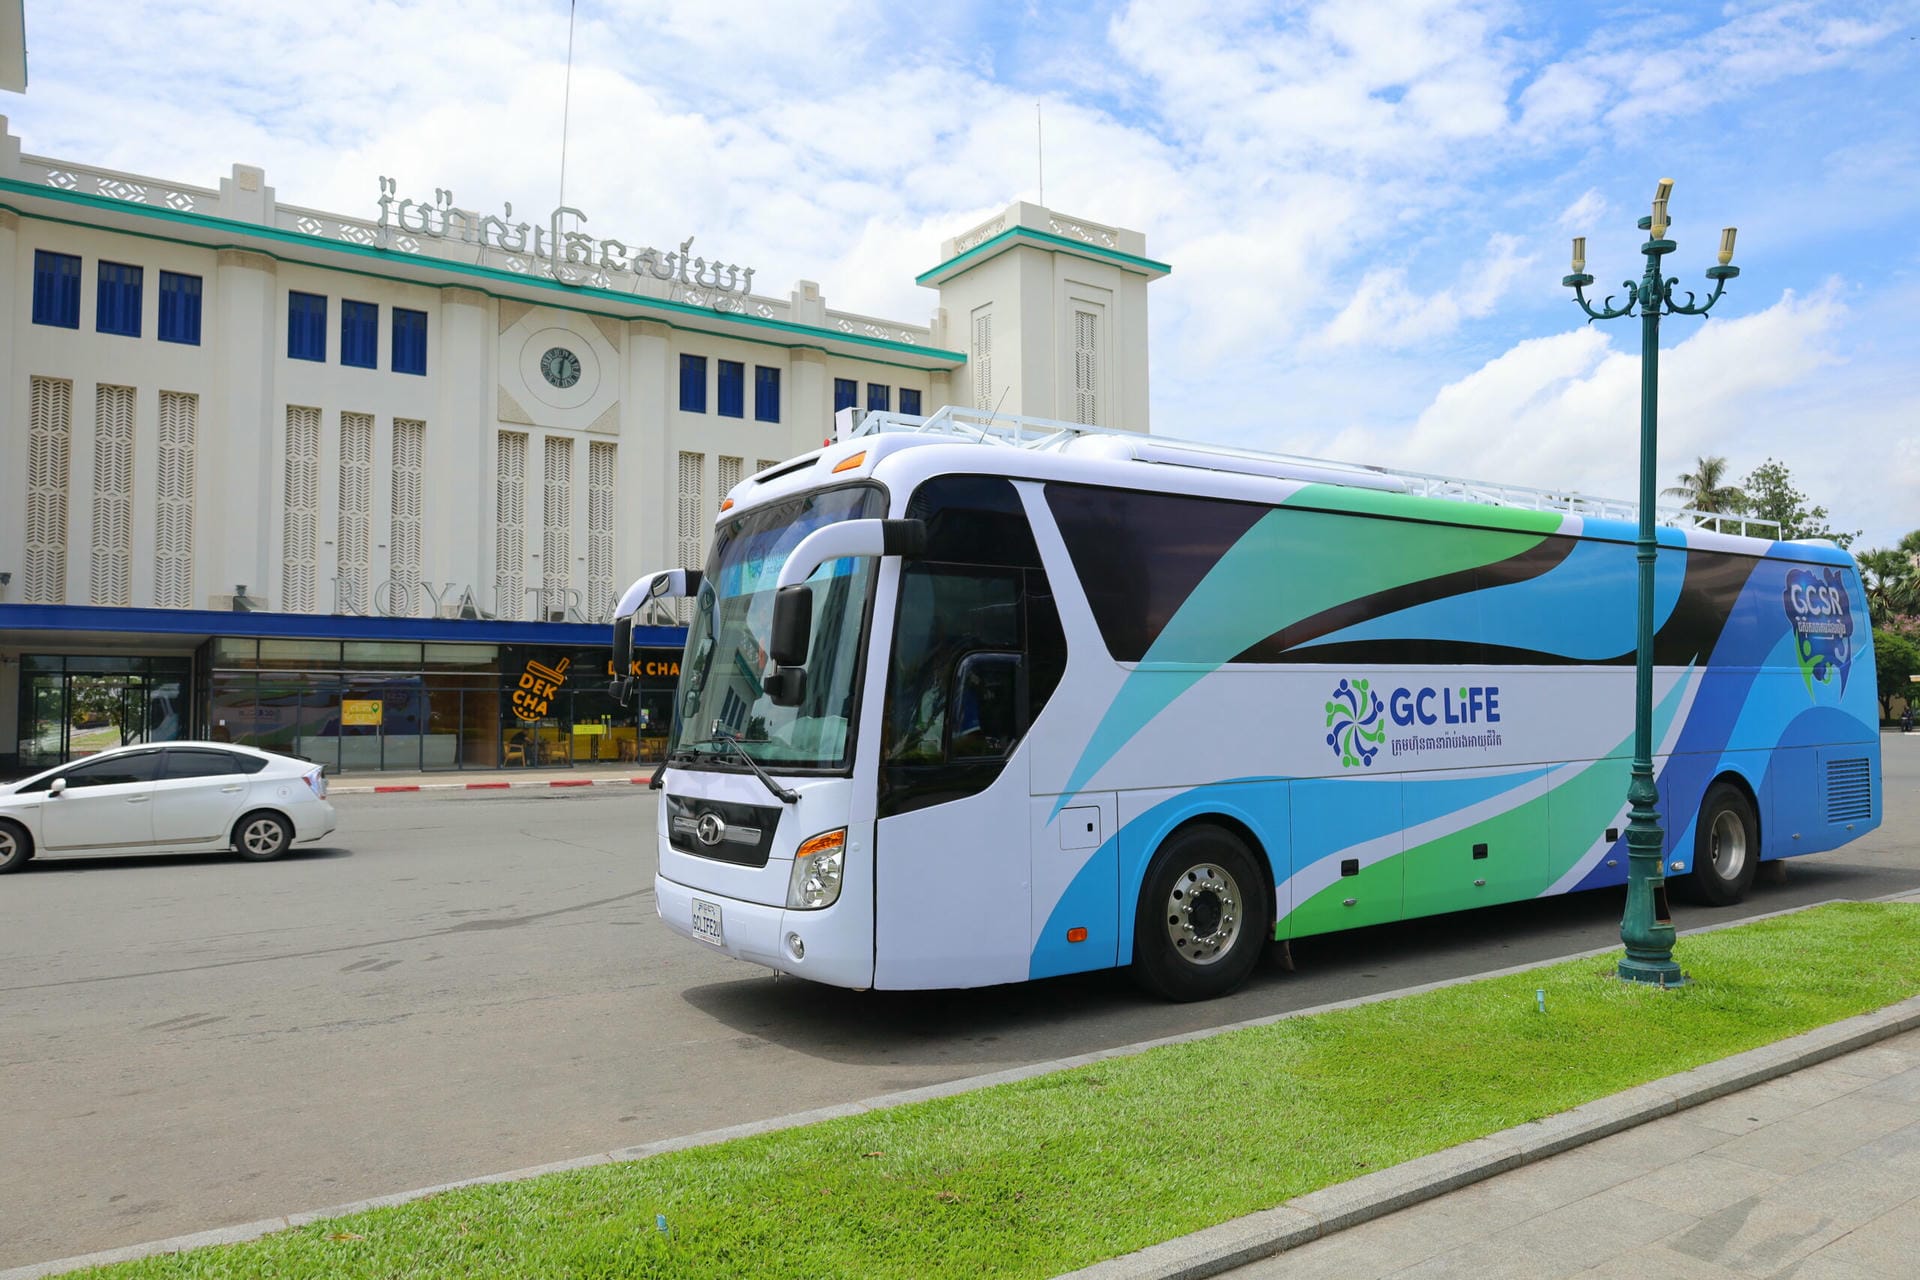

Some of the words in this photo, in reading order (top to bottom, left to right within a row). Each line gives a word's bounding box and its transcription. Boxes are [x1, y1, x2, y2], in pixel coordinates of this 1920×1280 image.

[330, 577, 515, 620] ROYAL
[1790, 584, 1843, 616] GCSR
[646, 661, 681, 676] CHA
[518, 672, 558, 701] DEK
[512, 689, 548, 716] CHA
[1389, 687, 1438, 726] GC
